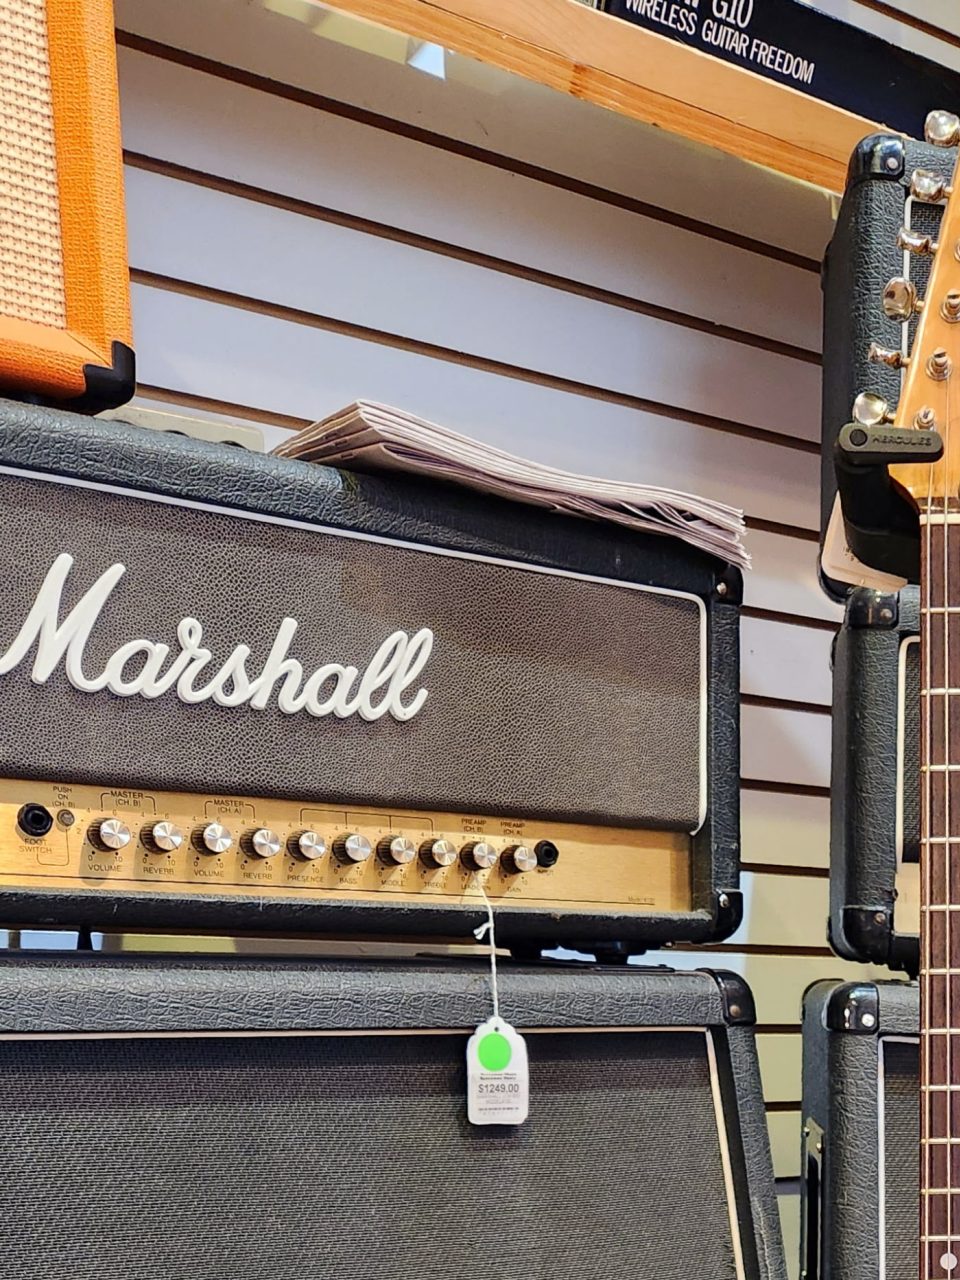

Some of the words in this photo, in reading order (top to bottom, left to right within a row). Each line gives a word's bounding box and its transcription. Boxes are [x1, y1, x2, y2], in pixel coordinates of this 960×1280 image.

[701, 19, 750, 58] GUITAR
[750, 37, 815, 85] FREEDOM
[0, 553, 434, 722] Marshall
[53, 785, 73, 793] PUSH
[57, 793, 69, 801] ON
[110, 789, 144, 799] MASTER
[213, 799, 245, 808] MASTER
[461, 818, 487, 826] PREAMP
[19, 845, 52, 854] SWITCH
[88, 864, 122, 873] VOLUME
[143, 867, 175, 875] REVERB
[194, 869, 225, 878] VOLUME
[243, 872, 273, 880] REVERB
[287, 874, 324, 884] PRESENCE
[339, 877, 358, 885] BASS
[478, 1083, 520, 1094] $1249.00
